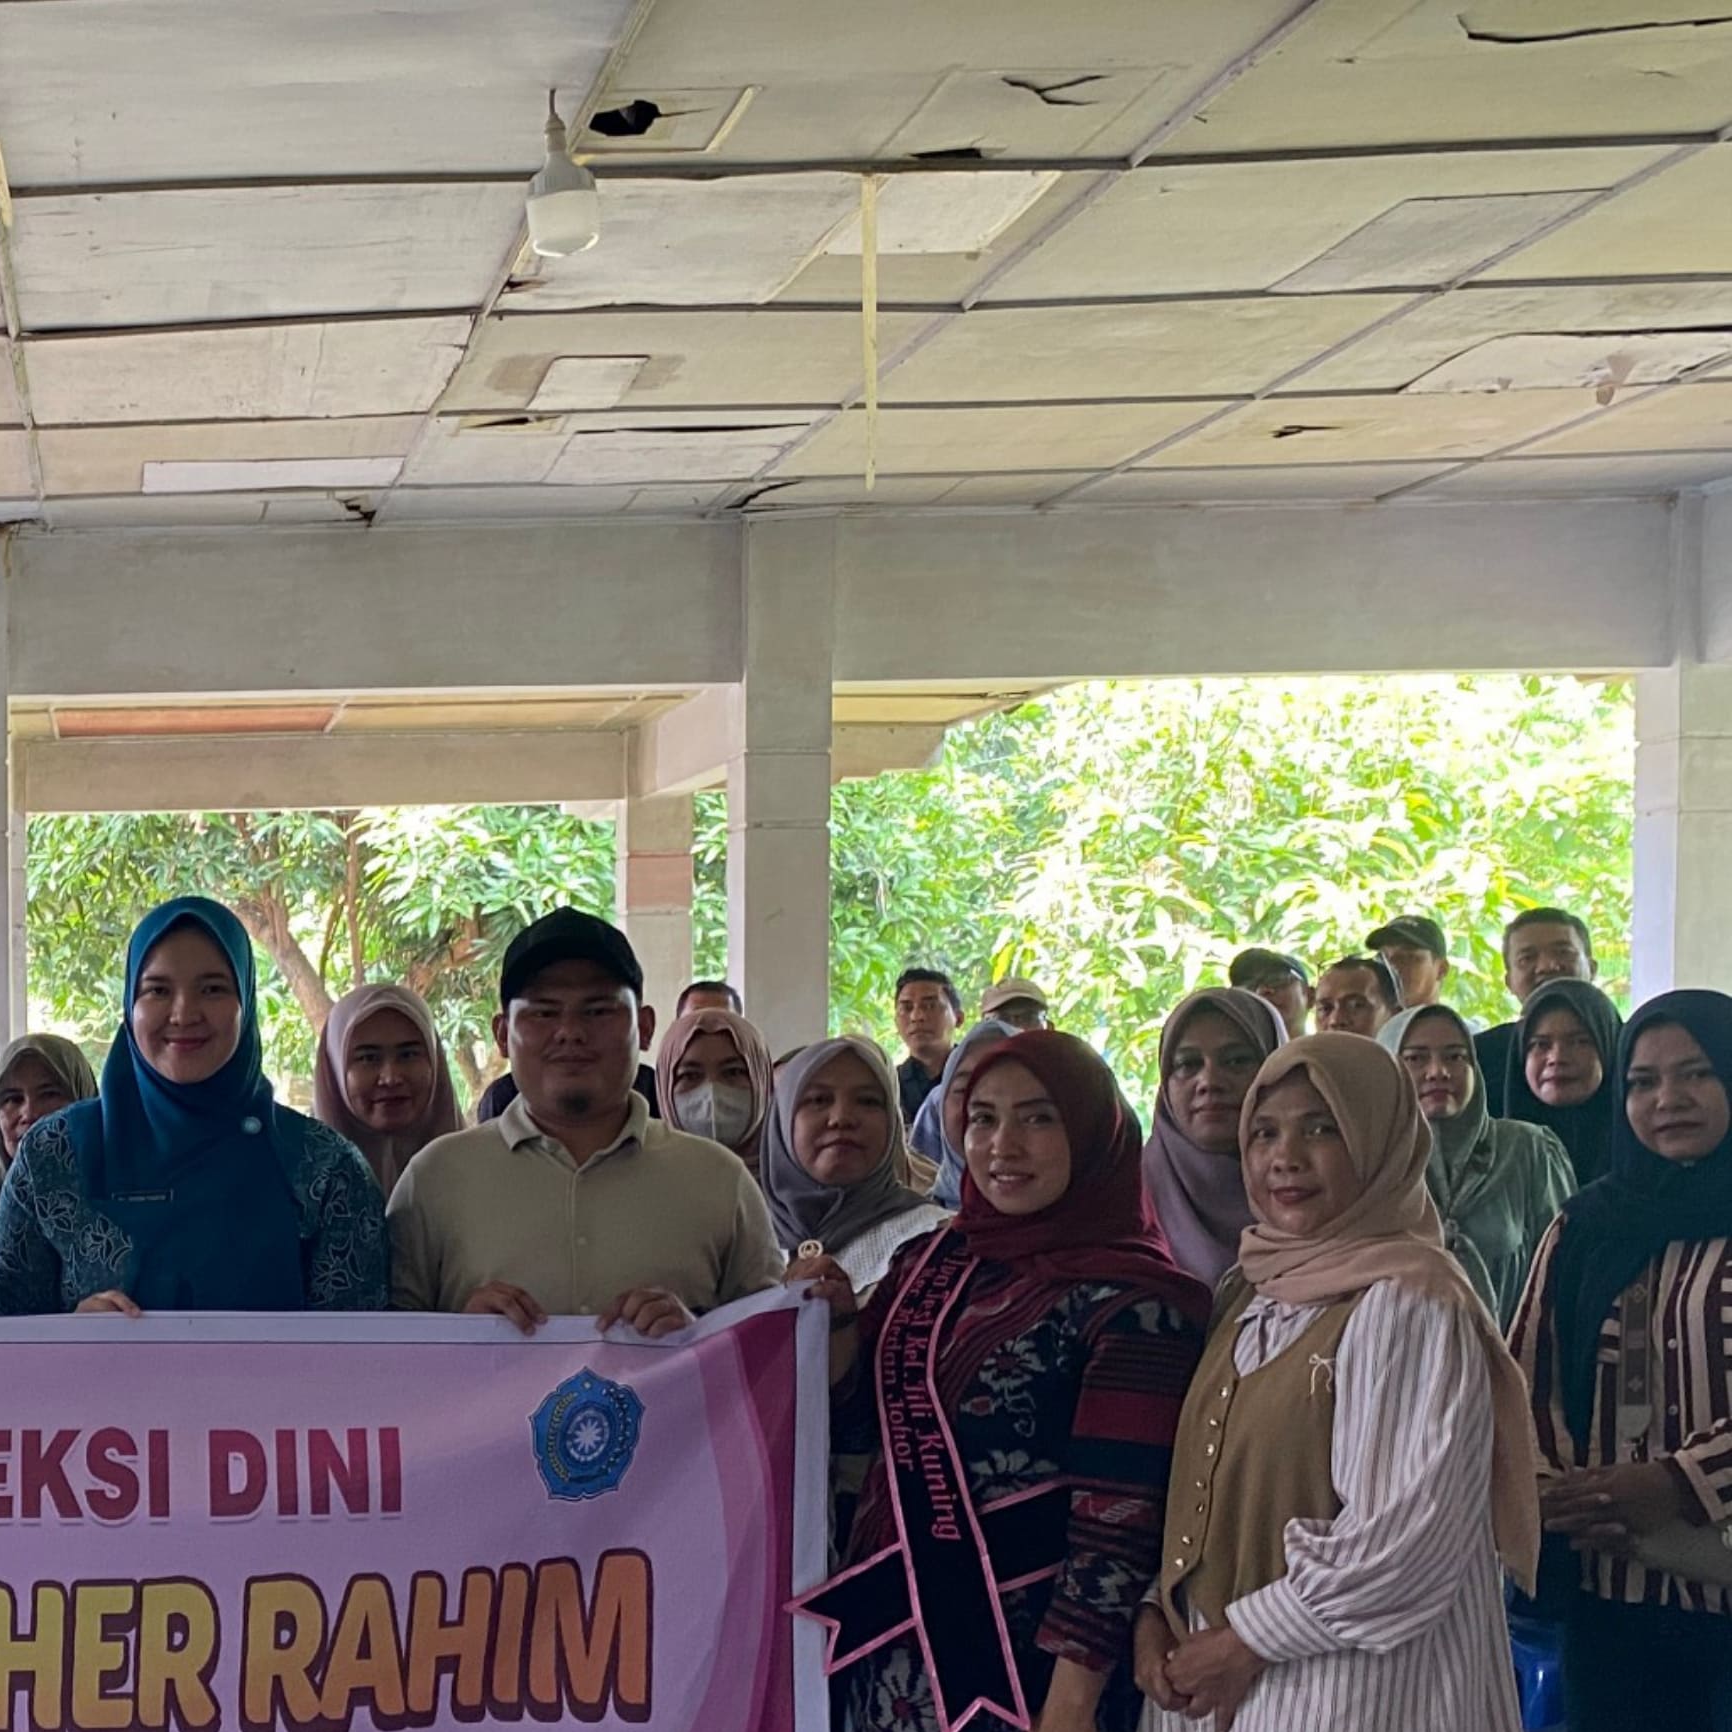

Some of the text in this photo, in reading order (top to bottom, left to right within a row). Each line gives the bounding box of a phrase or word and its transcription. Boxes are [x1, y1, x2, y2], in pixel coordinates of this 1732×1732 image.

[209, 1426, 403, 1519] DINI
[886, 1393, 915, 1472] Johor
[915, 1427, 962, 1541] Kuning
